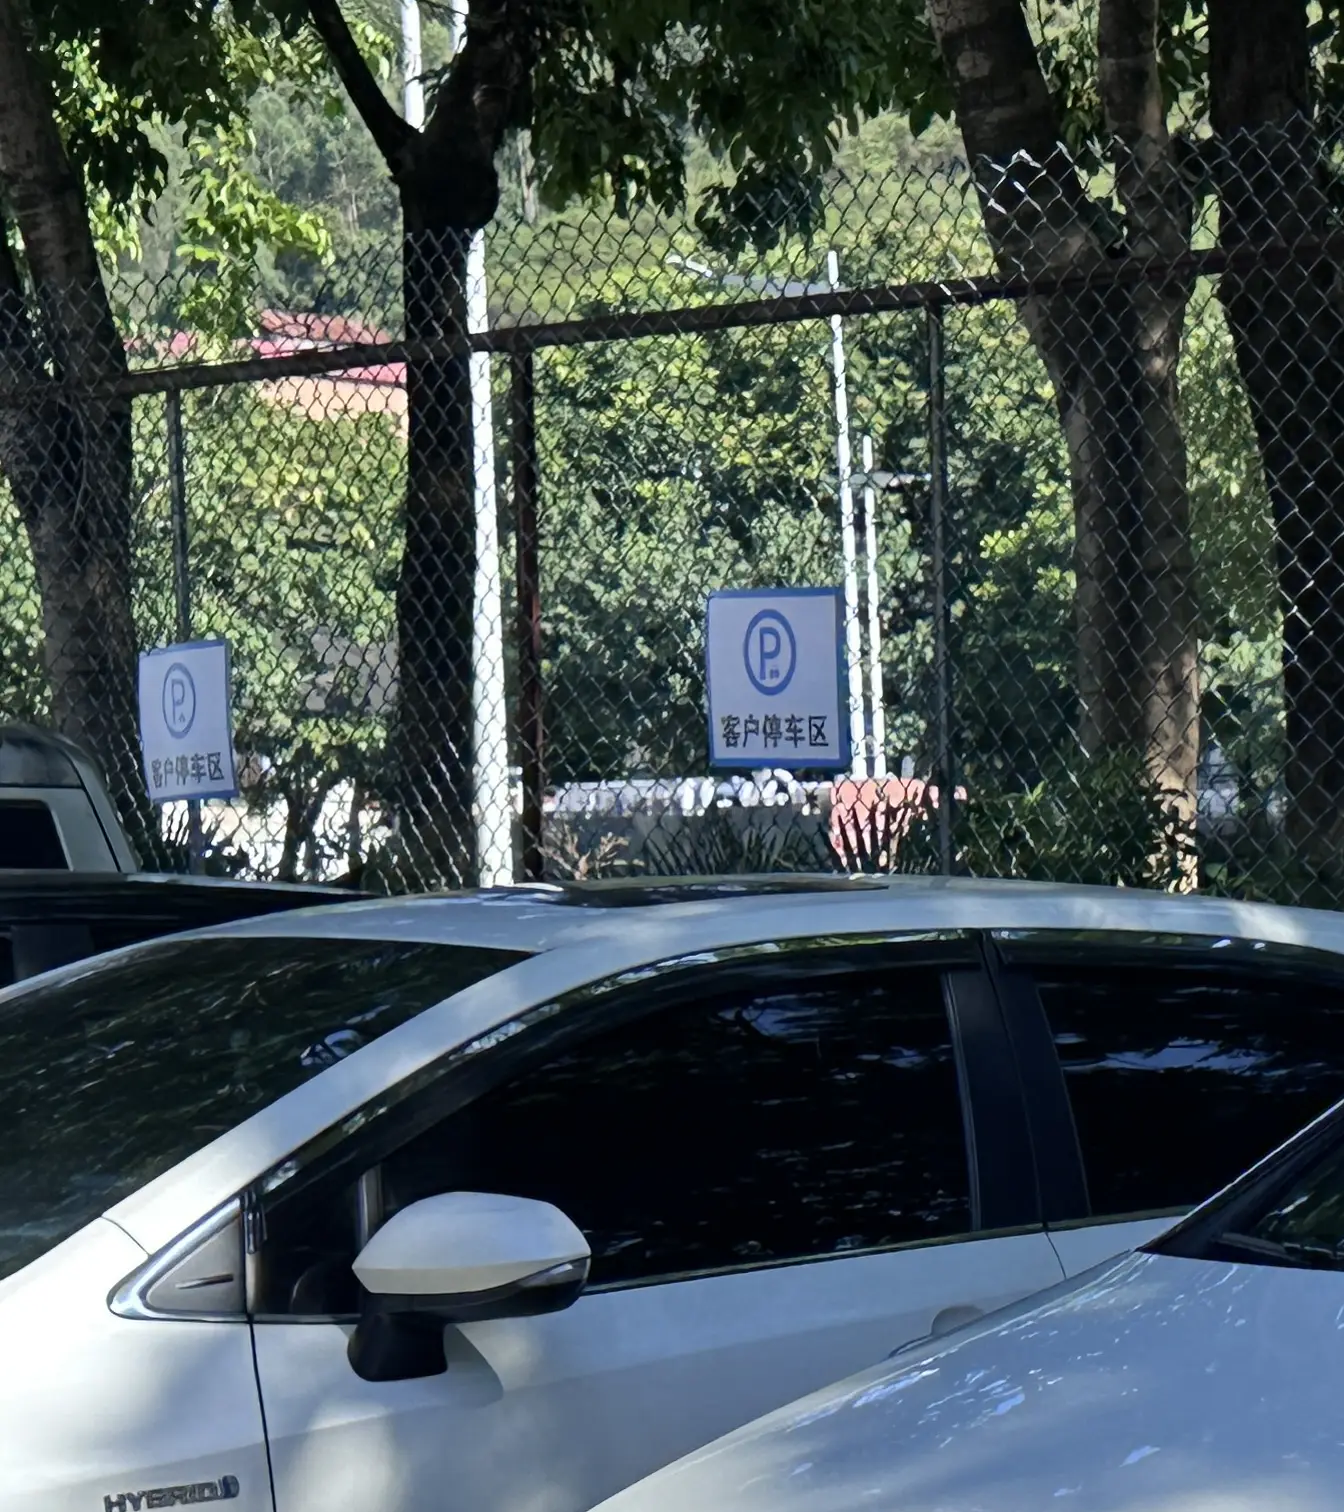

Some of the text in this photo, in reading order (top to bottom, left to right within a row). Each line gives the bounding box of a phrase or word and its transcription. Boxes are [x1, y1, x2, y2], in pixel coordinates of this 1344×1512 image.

[721, 714, 829, 748] 客户停车区
[152, 753, 224, 788] 客户停车区
